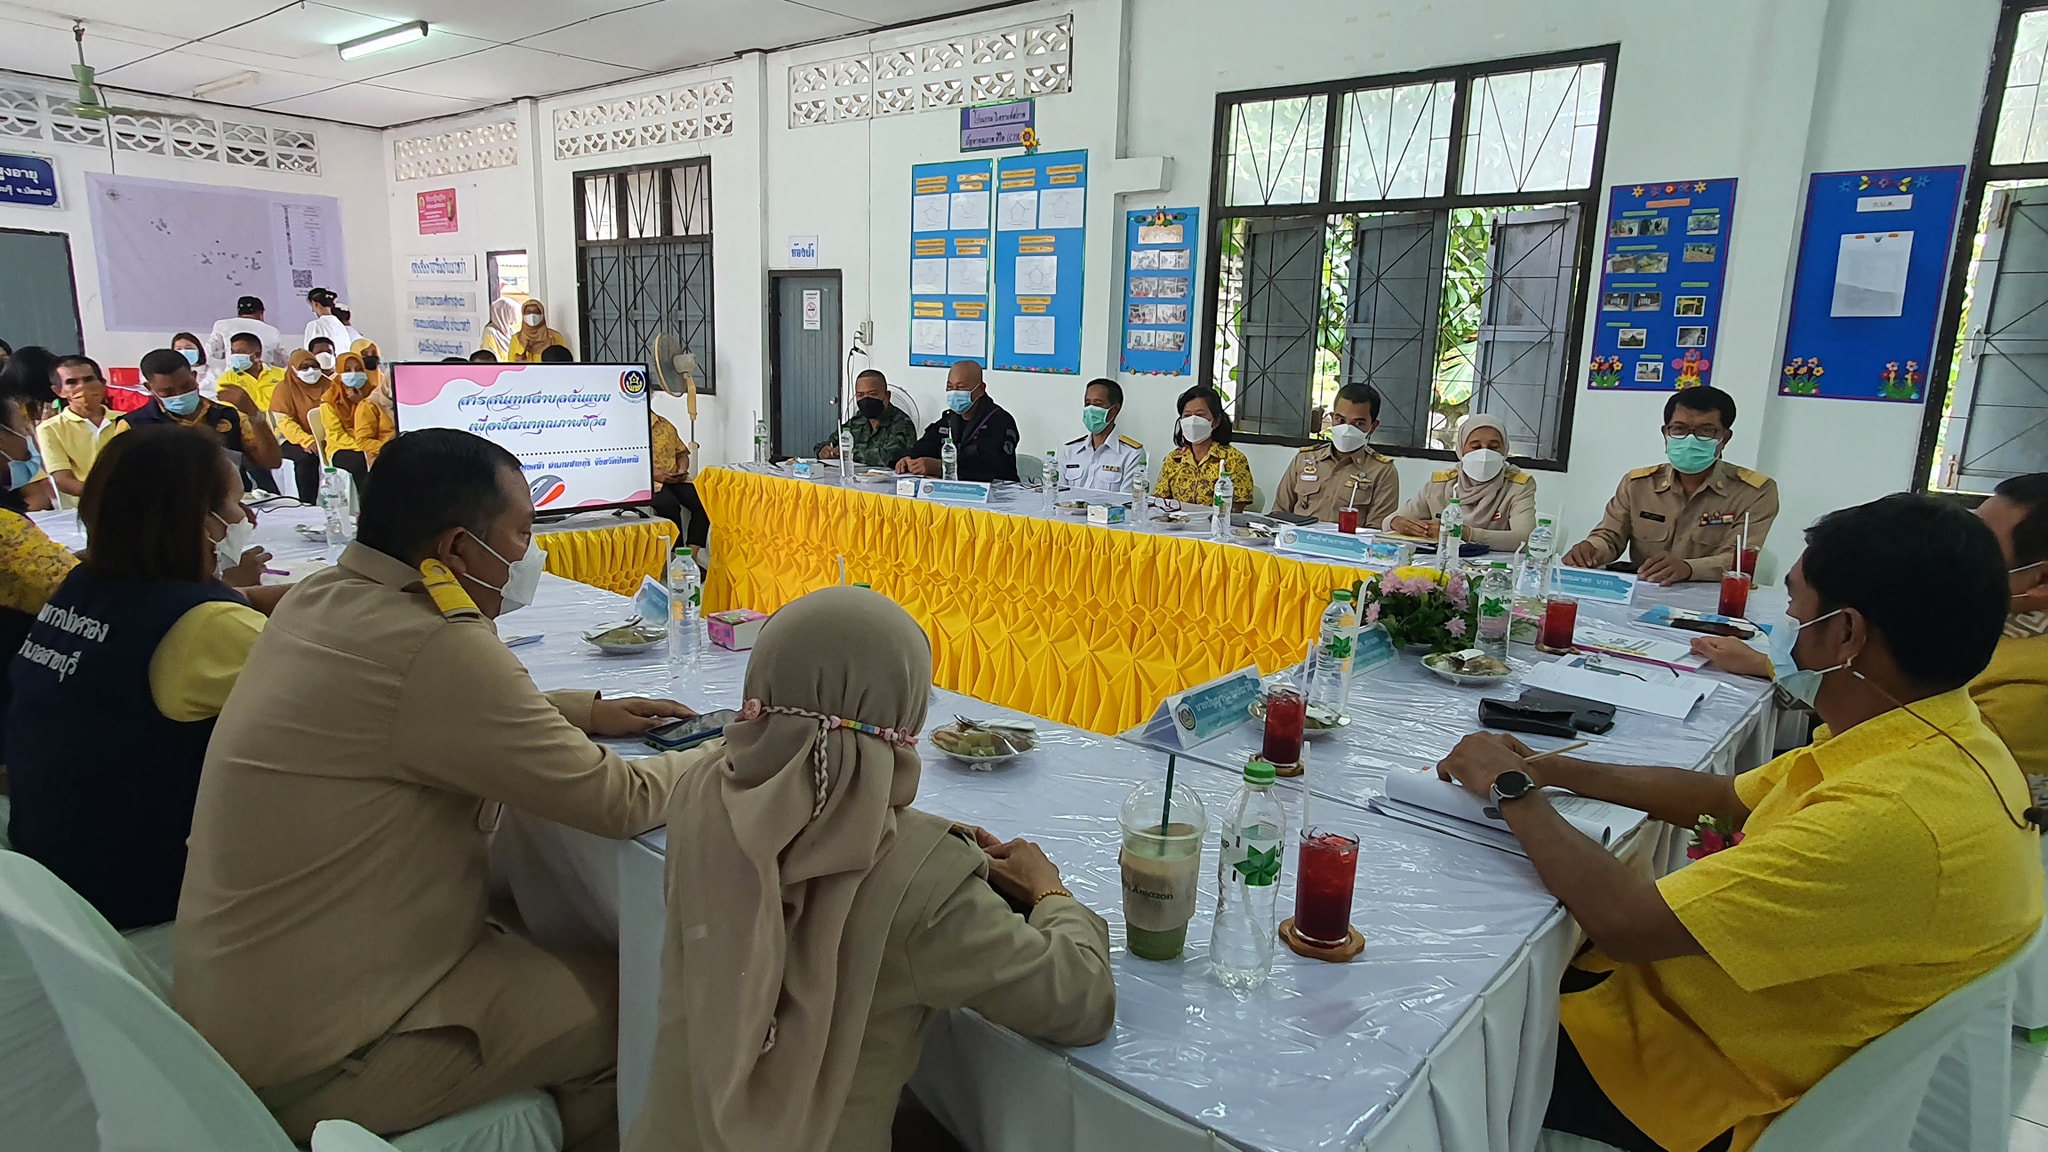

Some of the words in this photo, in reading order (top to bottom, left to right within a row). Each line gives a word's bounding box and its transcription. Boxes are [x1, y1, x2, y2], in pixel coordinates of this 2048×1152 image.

[458, 385, 612, 411] สารสนเทศตำบลต้นแบบ
[468, 413, 608, 436] เพื่อพัฒนาคุณภาพชีวิต
[1131, 885, 1174, 901] Amazon
